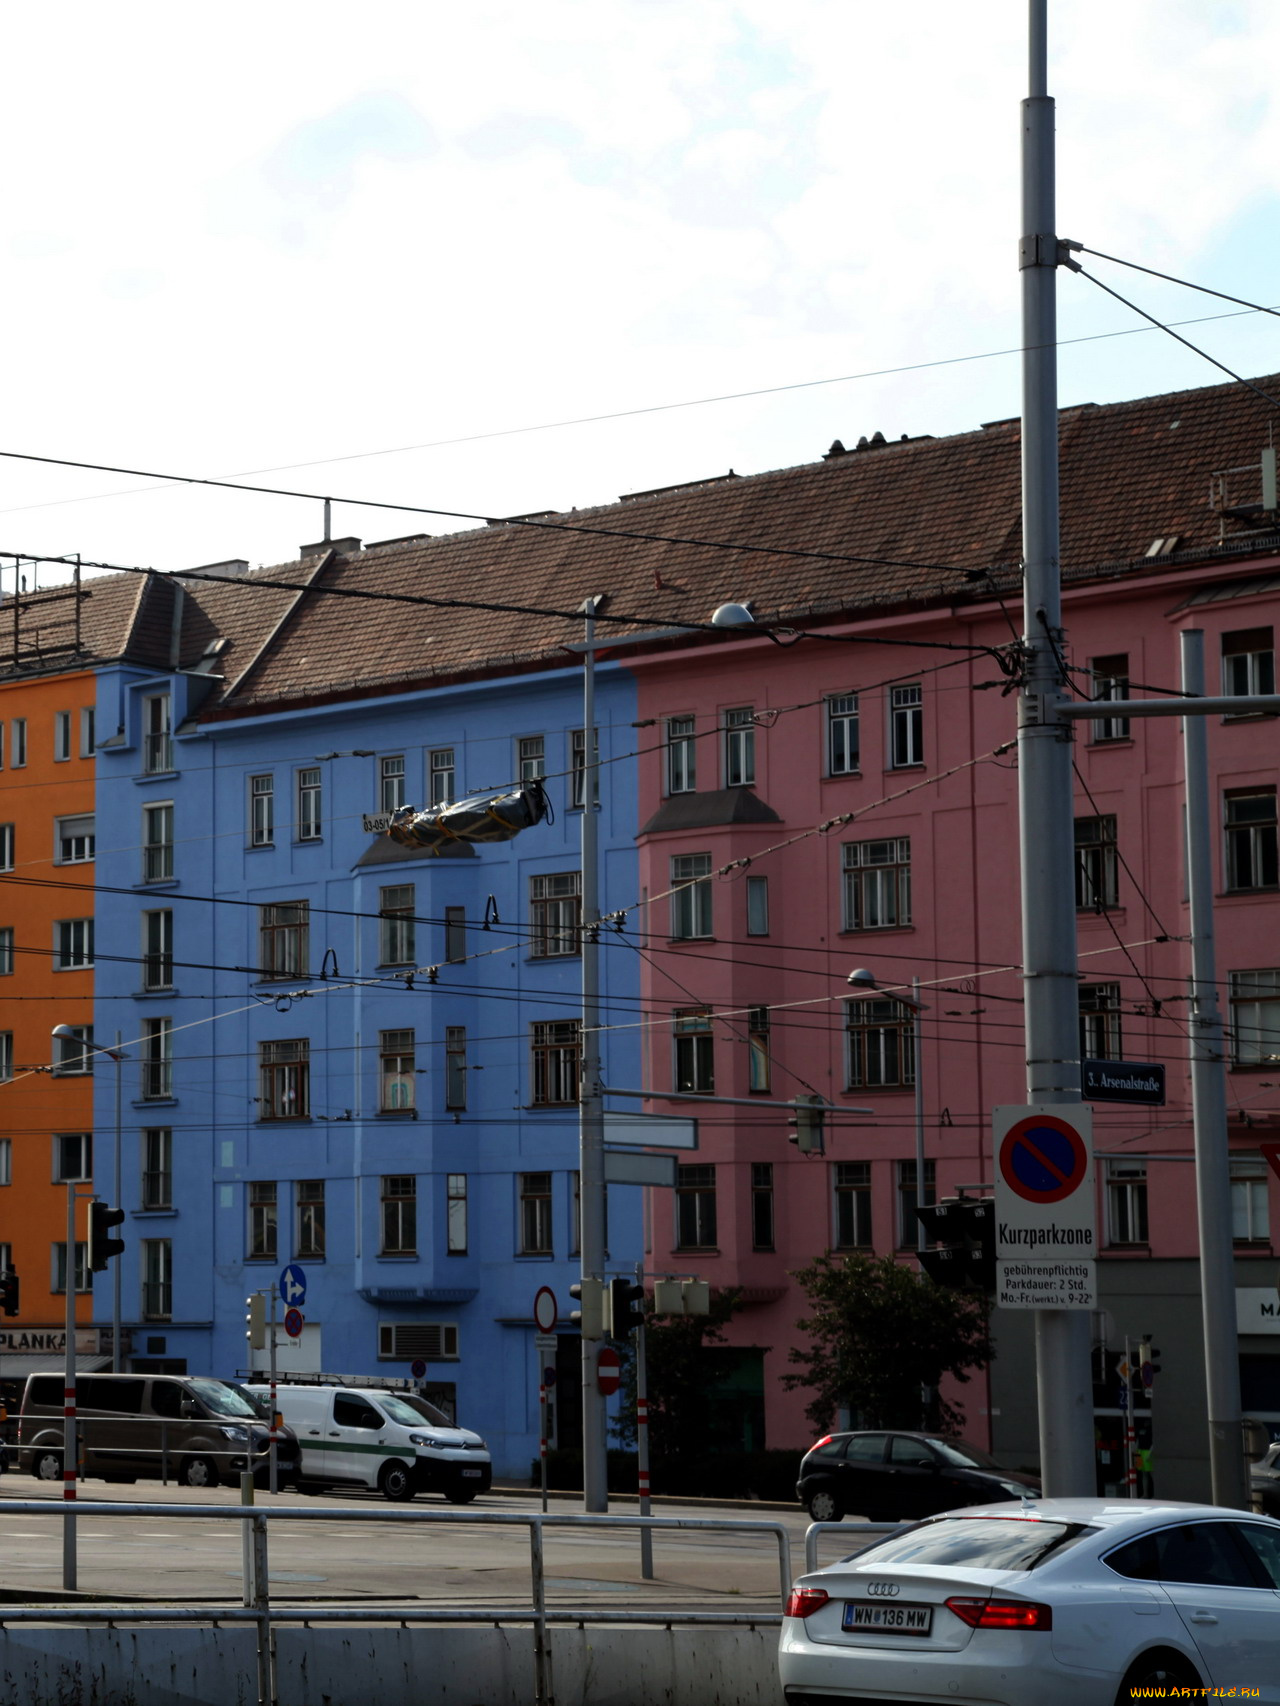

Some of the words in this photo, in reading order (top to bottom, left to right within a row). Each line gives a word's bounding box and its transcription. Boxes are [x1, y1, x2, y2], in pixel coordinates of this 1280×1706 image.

[1100, 1073, 1160, 1092] Arsenalstraße
[999, 1223, 1092, 1250] Kurzparkzone
[1003, 1264, 1089, 1278] gebührenpflichtig
[1006, 1279, 1057, 1290] Parkdauer:
[1060, 1279, 1065, 1290] 2
[1068, 1279, 1087, 1291] Std.
[854, 1607, 873, 1625] WN
[882, 1609, 905, 1626] 136
[906, 1611, 927, 1628] MW
